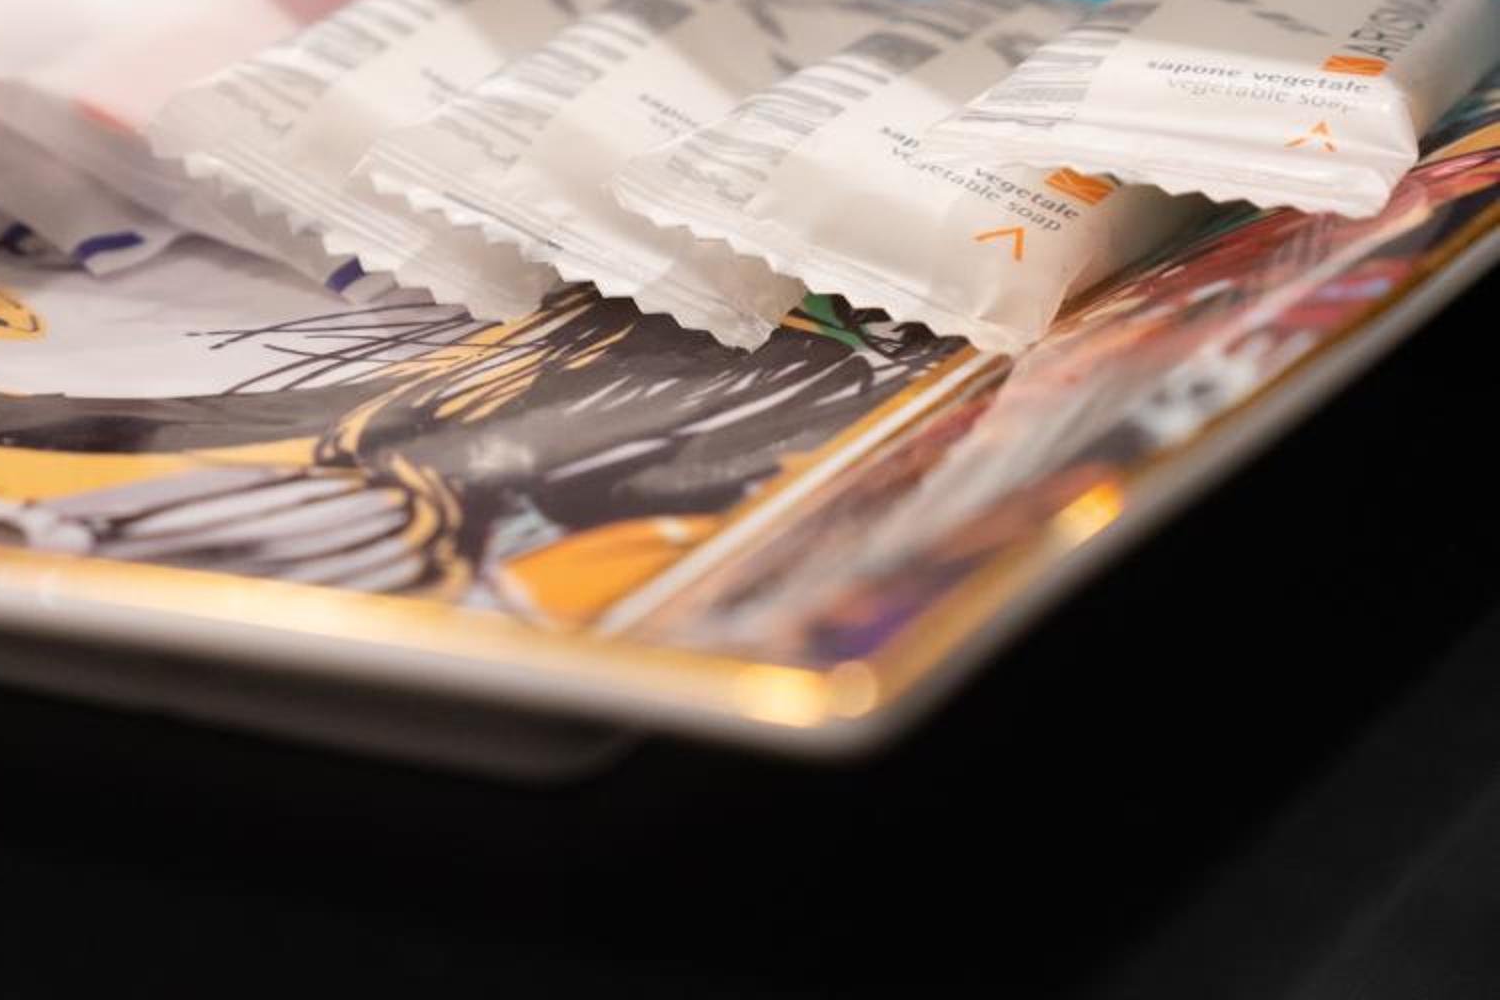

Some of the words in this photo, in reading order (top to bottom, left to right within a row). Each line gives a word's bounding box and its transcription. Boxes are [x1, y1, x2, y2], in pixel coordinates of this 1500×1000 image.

[1146, 60, 1243, 78] sapone
[1252, 70, 1371, 94] vegetale
[877, 124, 921, 150] sap
[973, 165, 1081, 221] vegetale
[1006, 200, 1063, 233] soap
